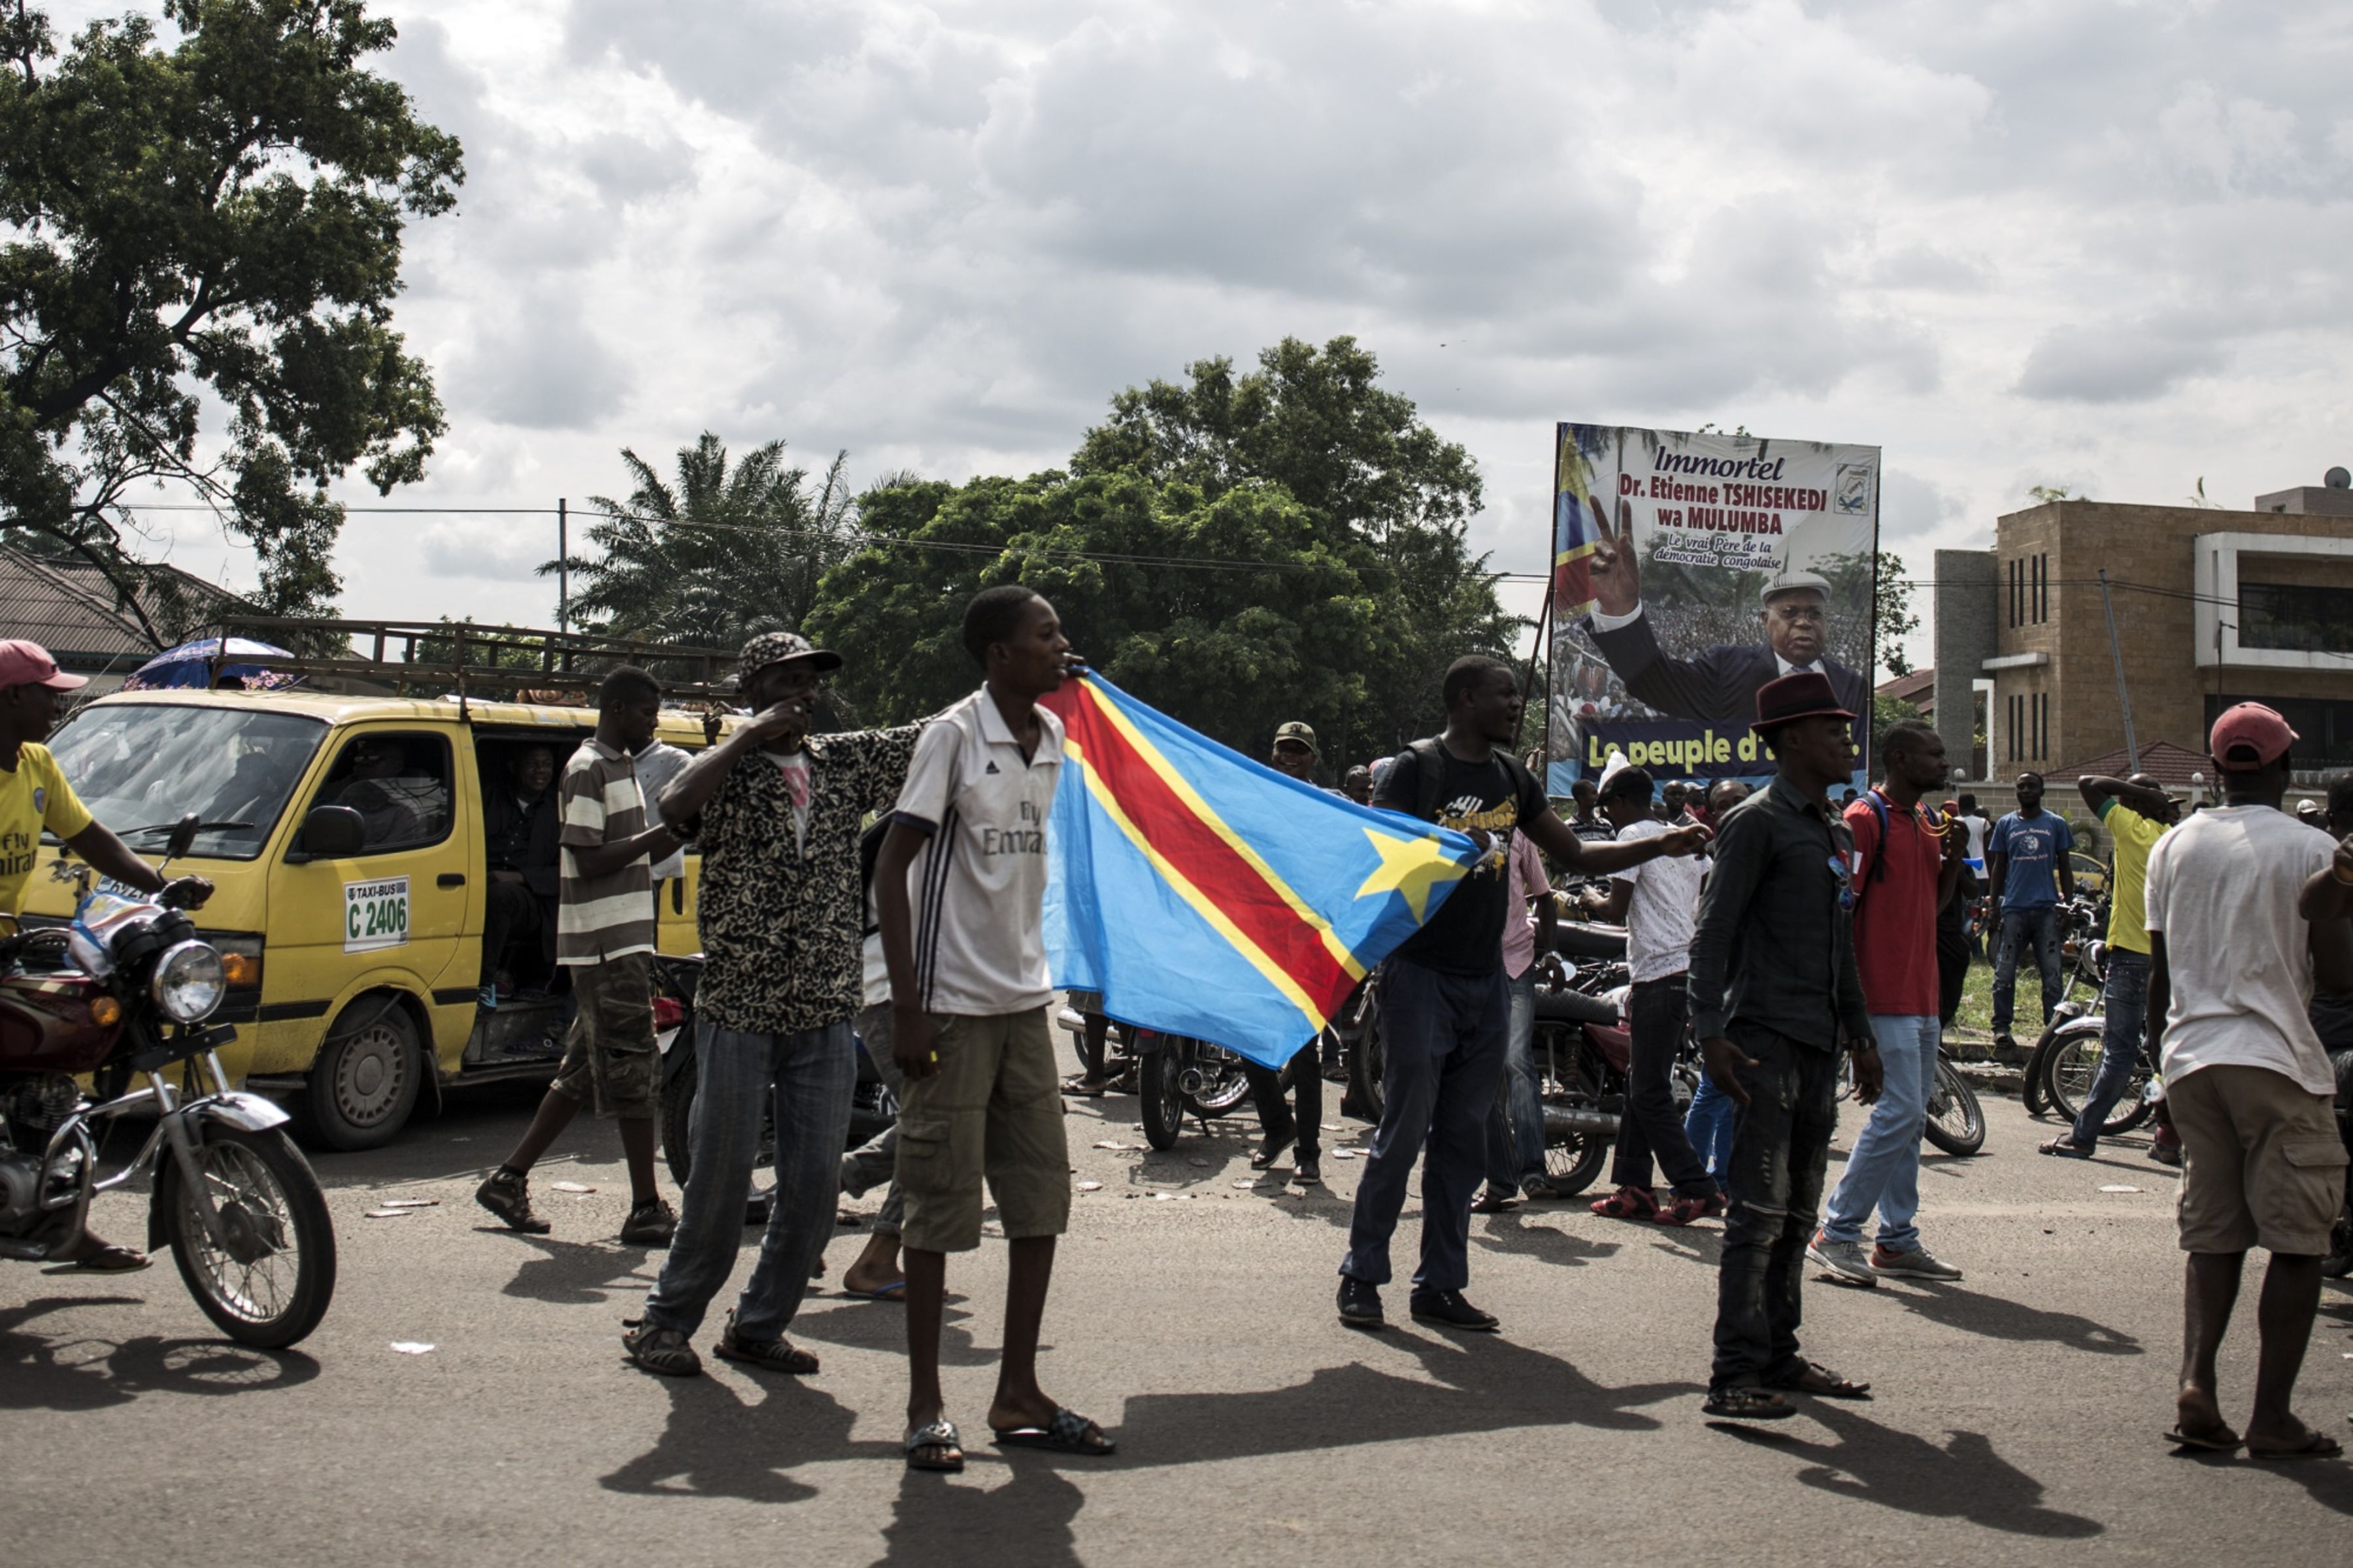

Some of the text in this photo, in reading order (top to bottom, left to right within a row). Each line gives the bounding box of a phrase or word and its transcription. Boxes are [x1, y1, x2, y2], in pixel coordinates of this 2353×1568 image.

[1655, 446, 1785, 480] Immortel
[1620, 474, 1827, 511] Dr. Etienne TSHISEKEDI
[1658, 507, 1782, 535] wa MULUMBA
[1656, 548, 1782, 569] démocratie congolaise
[1669, 533, 1771, 553] Le vrai Père de la
[1629, 729, 1731, 774] peuple
[357, 884, 396, 899] TAXI-BUS
[349, 897, 407, 939] C 2406
